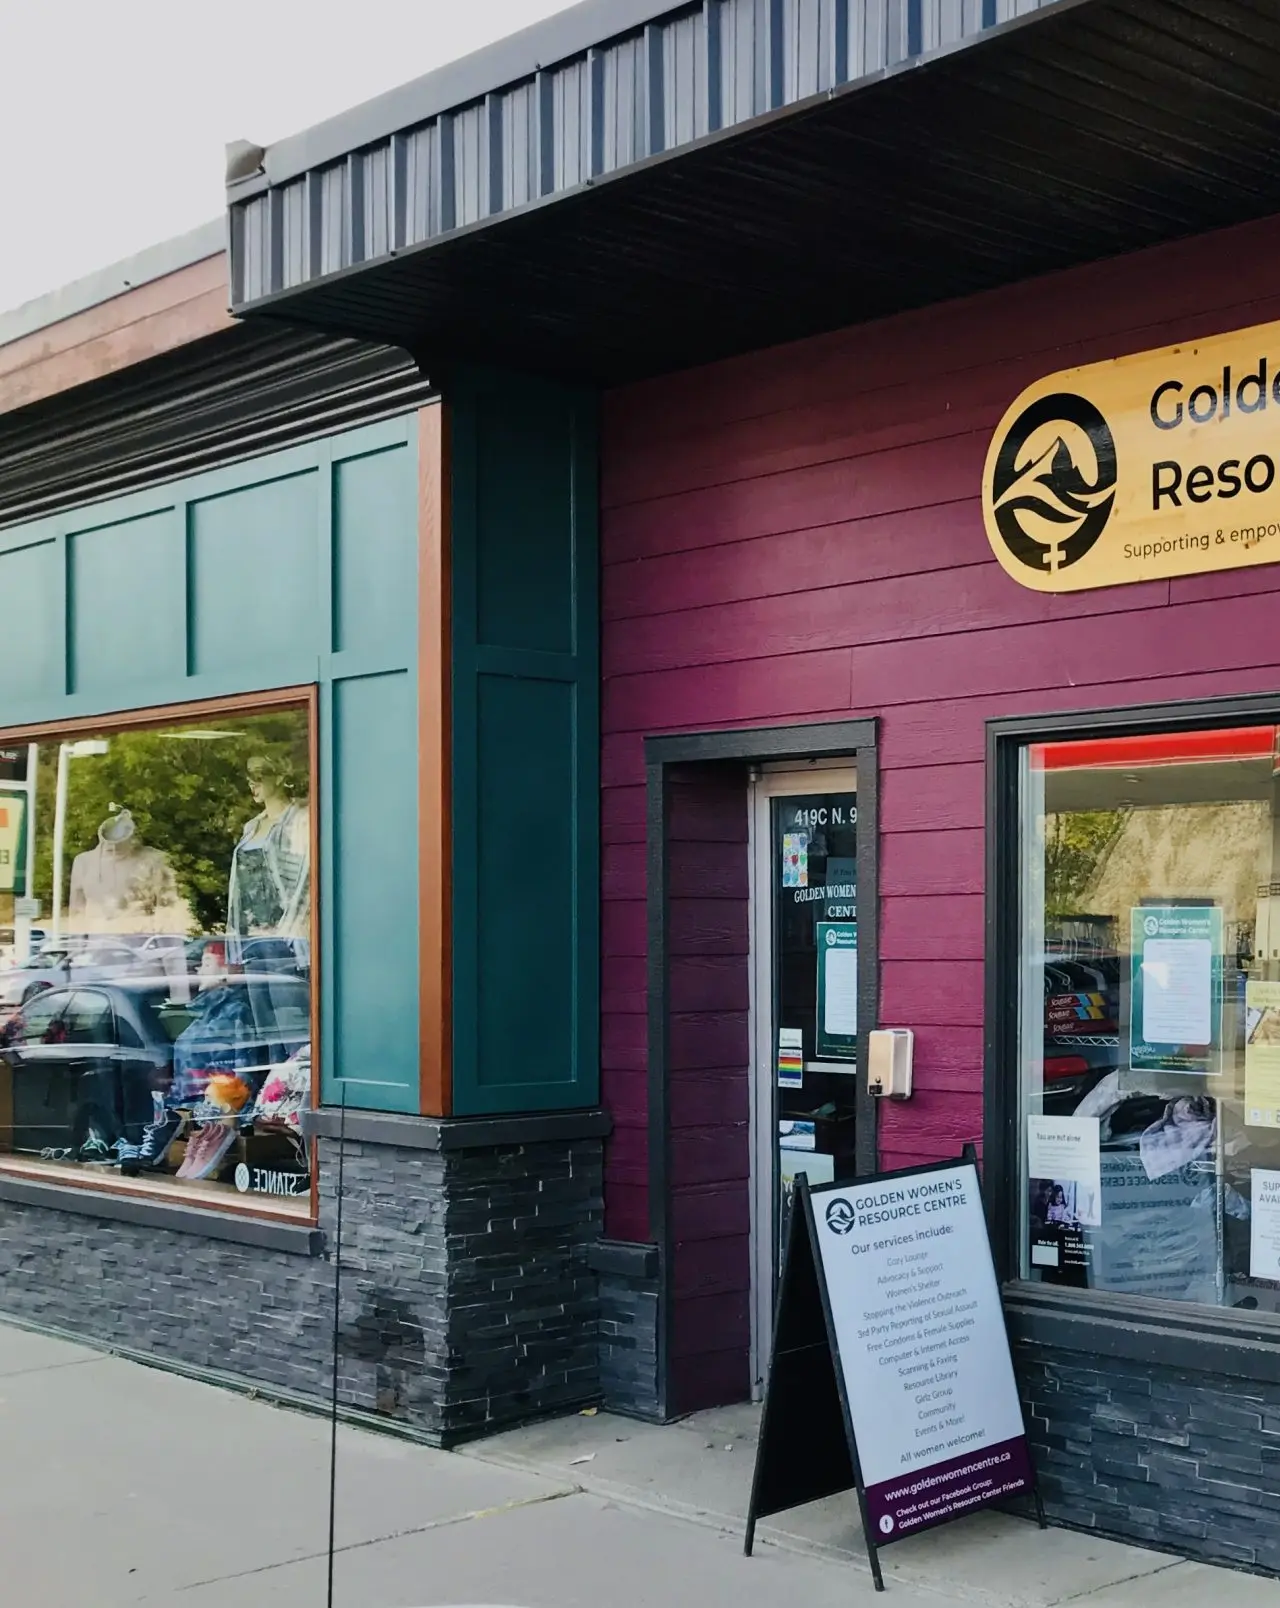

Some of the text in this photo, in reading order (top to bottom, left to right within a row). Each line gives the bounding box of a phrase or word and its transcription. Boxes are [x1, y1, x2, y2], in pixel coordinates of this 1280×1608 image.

[1123, 532, 1210, 560] Supporting
[1215, 530, 1225, 544] &
[794, 809, 828, 826] 419C
[832, 807, 846, 825] N.
[794, 884, 856, 903] GOLDEN WOMEN
[828, 905, 856, 918] CENT
[855, 1179, 963, 1210] GOLDEN WOMEN'S
[858, 1194, 967, 1227] RESOURCE CENTRE
[851, 1225, 954, 1255] Our services include:
[877, 1272, 909, 1285] Advocacy
[917, 1262, 943, 1276] Support
[863, 1287, 967, 1321] Stopping the Violence Outreach
[885, 1280, 941, 1299] Women's Shelter
[857, 1300, 978, 1339] 3rd Party Reporting of Sexual Assault
[867, 1317, 975, 1353] Free Condoms & Female Supplies
[879, 1335, 970, 1366] Computer & Internet Access
[898, 1354, 958, 1377] Scanning & Faxing
[903, 1369, 958, 1391] Resource Library
[932, 1387, 954, 1400] Group
[915, 1413, 965, 1438] Events & More!
[918, 1401, 956, 1420] Community
[900, 1428, 986, 1464] All women welcome!
[884, 1451, 1011, 1502] www.goldenwomencentre.ca
[895, 1478, 993, 1518] Check out our Facebook Group:
[898, 1478, 1025, 1529] Golden Women's Resource Center Friends
